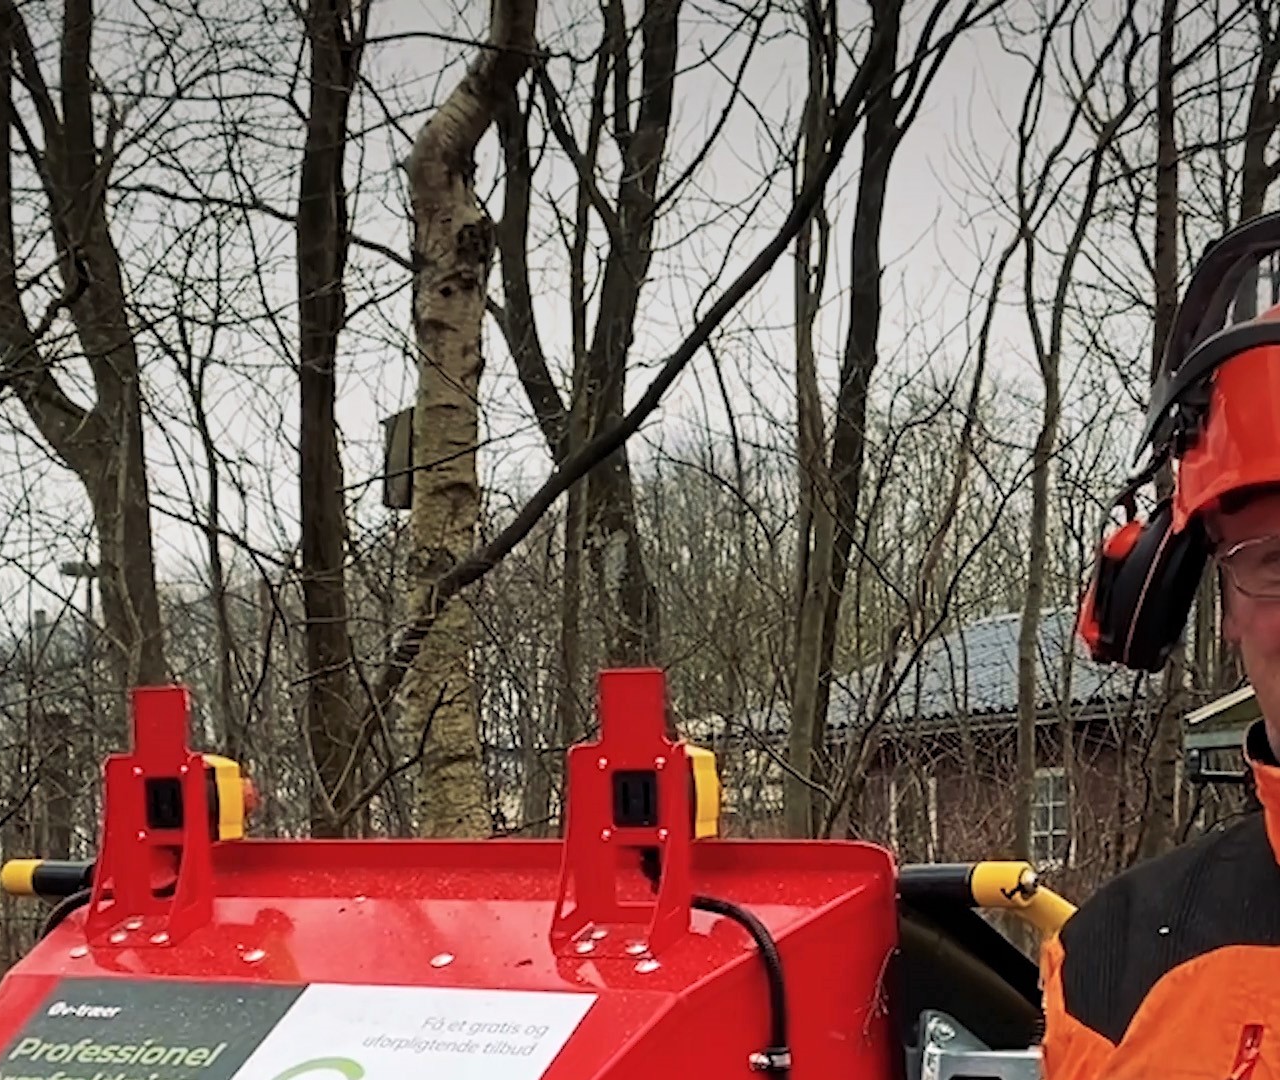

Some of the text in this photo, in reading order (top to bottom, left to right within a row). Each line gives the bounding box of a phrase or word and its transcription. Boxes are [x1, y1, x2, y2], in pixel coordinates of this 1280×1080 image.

[421, 1016, 550, 1039] Få et gratis og
[8, 1036, 229, 1068] Professionel
[362, 1034, 539, 1057] uforpligtende tilbud
